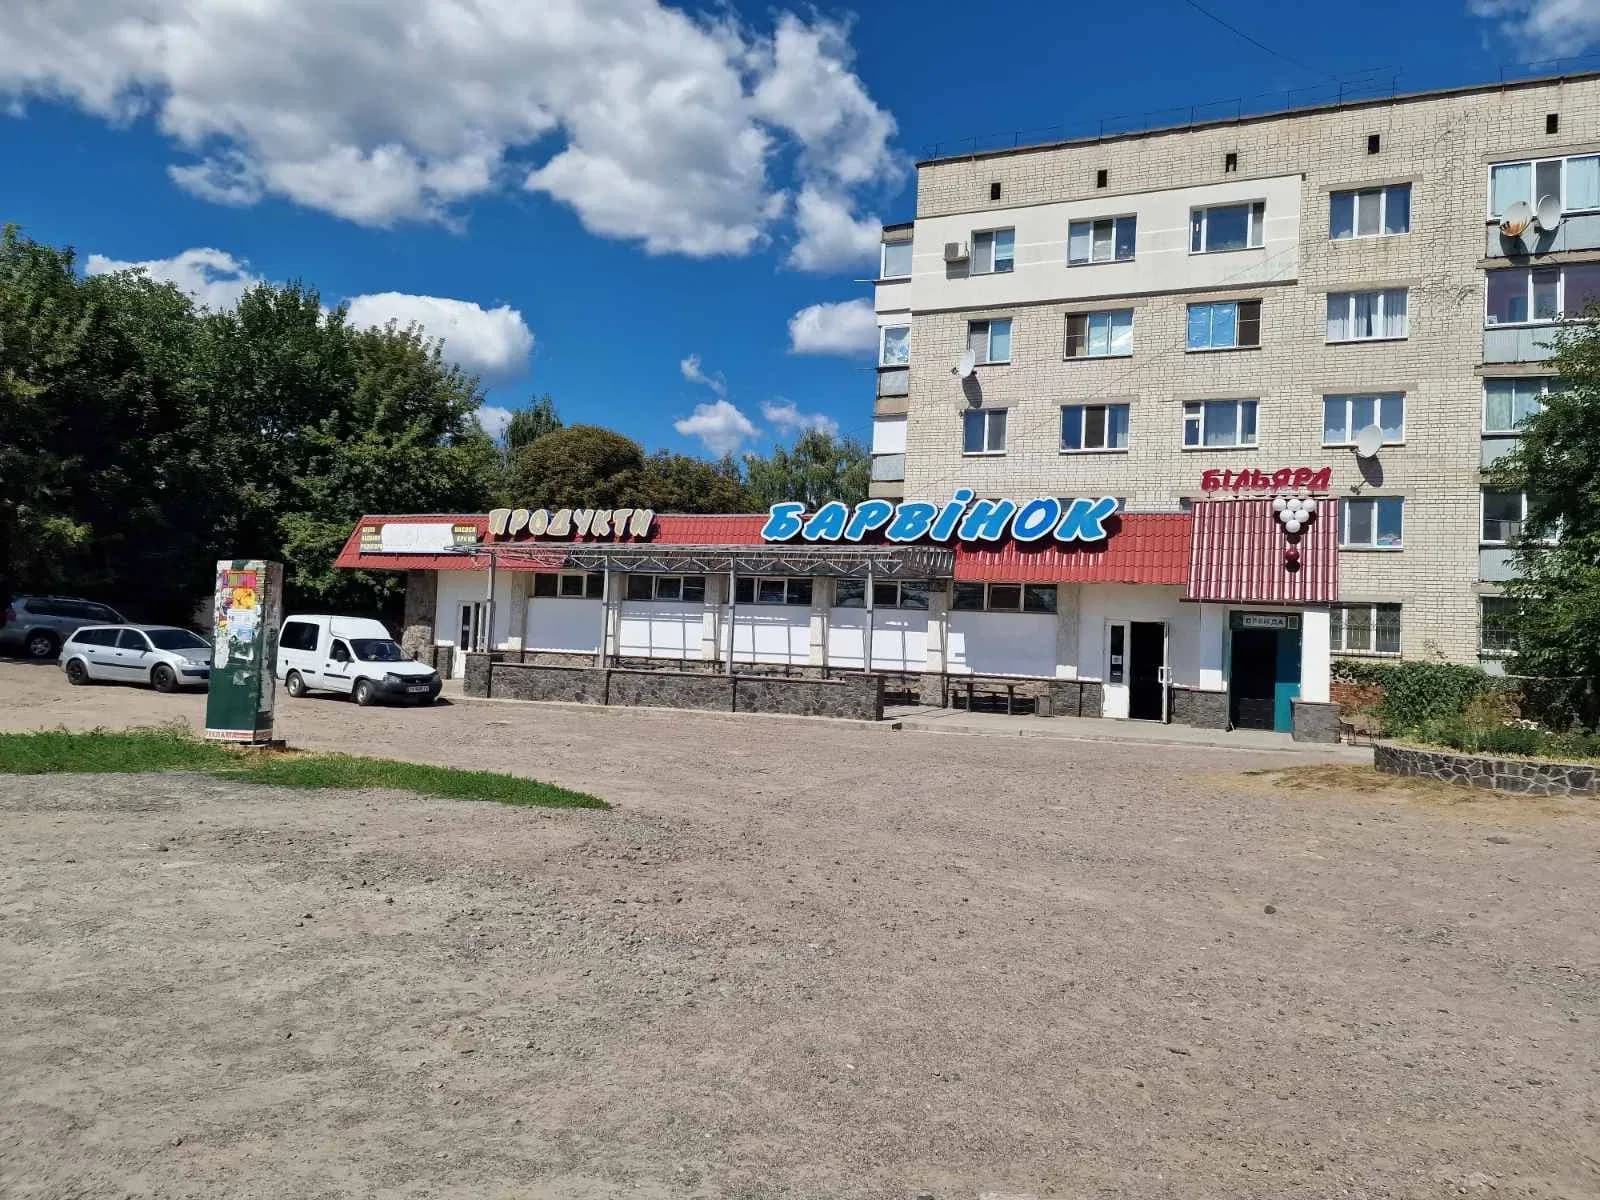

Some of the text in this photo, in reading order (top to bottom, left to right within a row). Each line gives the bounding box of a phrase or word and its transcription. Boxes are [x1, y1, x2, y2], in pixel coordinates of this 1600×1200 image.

[1201, 466, 1332, 493] БІЛЬЯРД
[488, 508, 654, 537] ПРОДУКТИ
[761, 488, 1119, 542] БАРВІНОК
